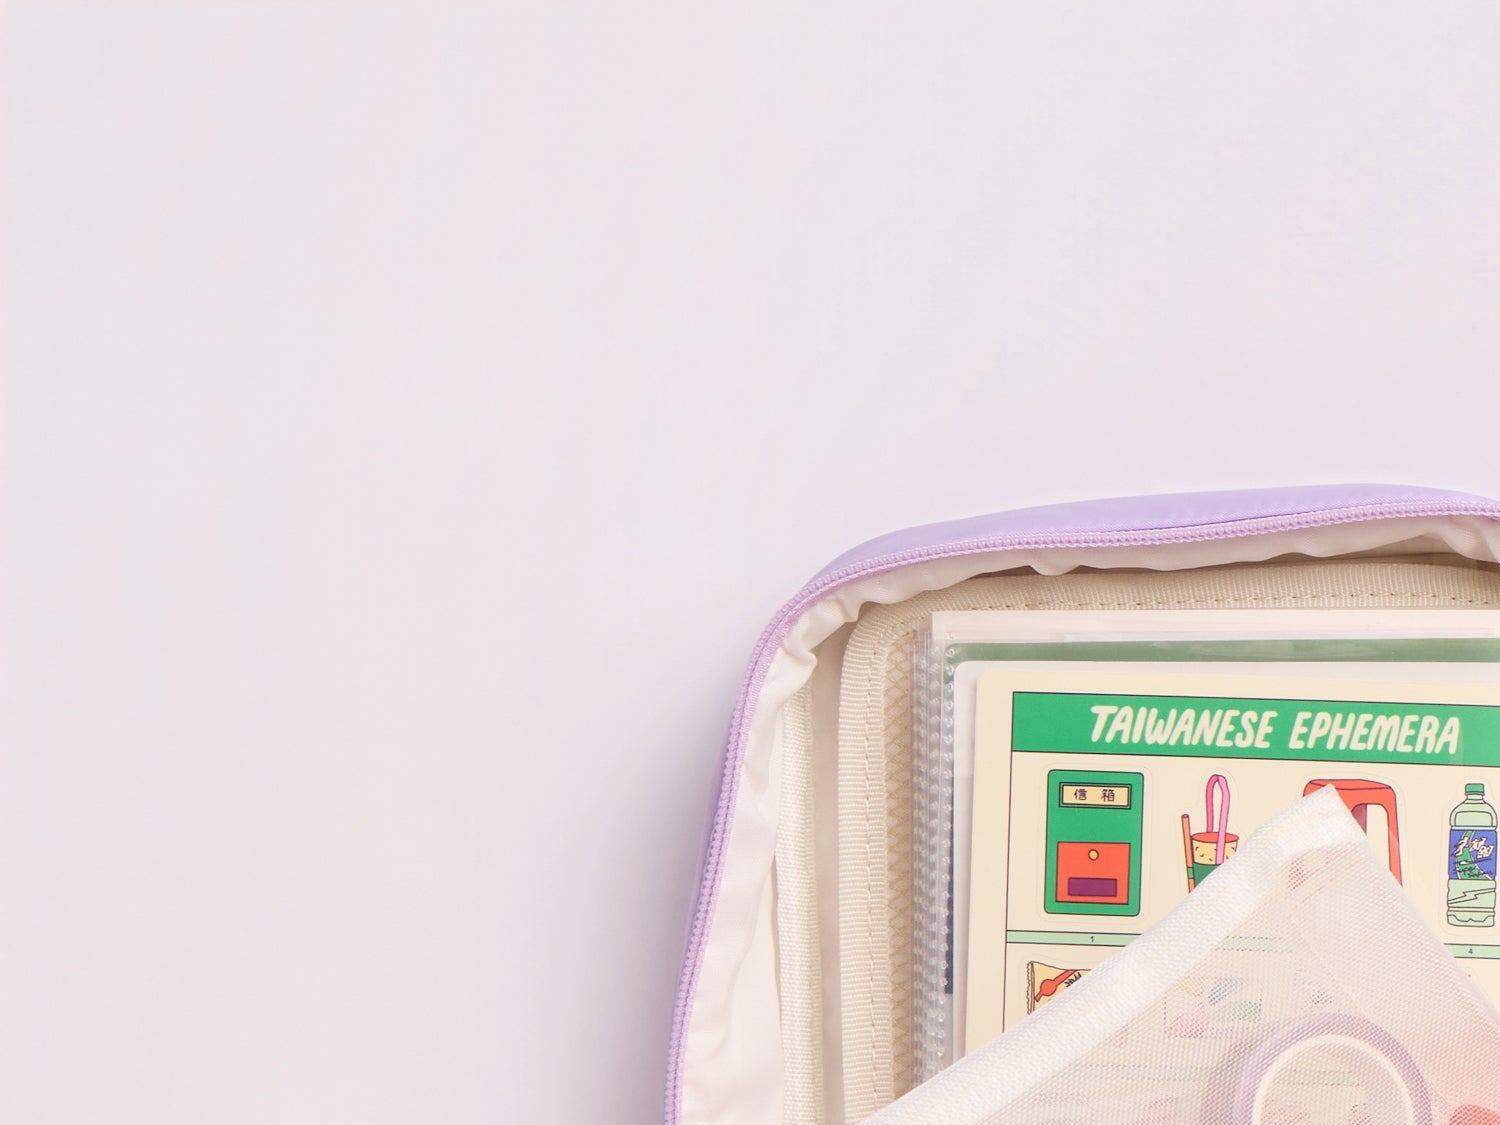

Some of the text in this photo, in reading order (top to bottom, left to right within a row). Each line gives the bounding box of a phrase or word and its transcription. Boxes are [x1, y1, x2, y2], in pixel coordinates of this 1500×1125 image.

[1090, 705, 1460, 755] TAIWANESE EPHEMERA
[1073, 788, 1116, 803] 信箱
